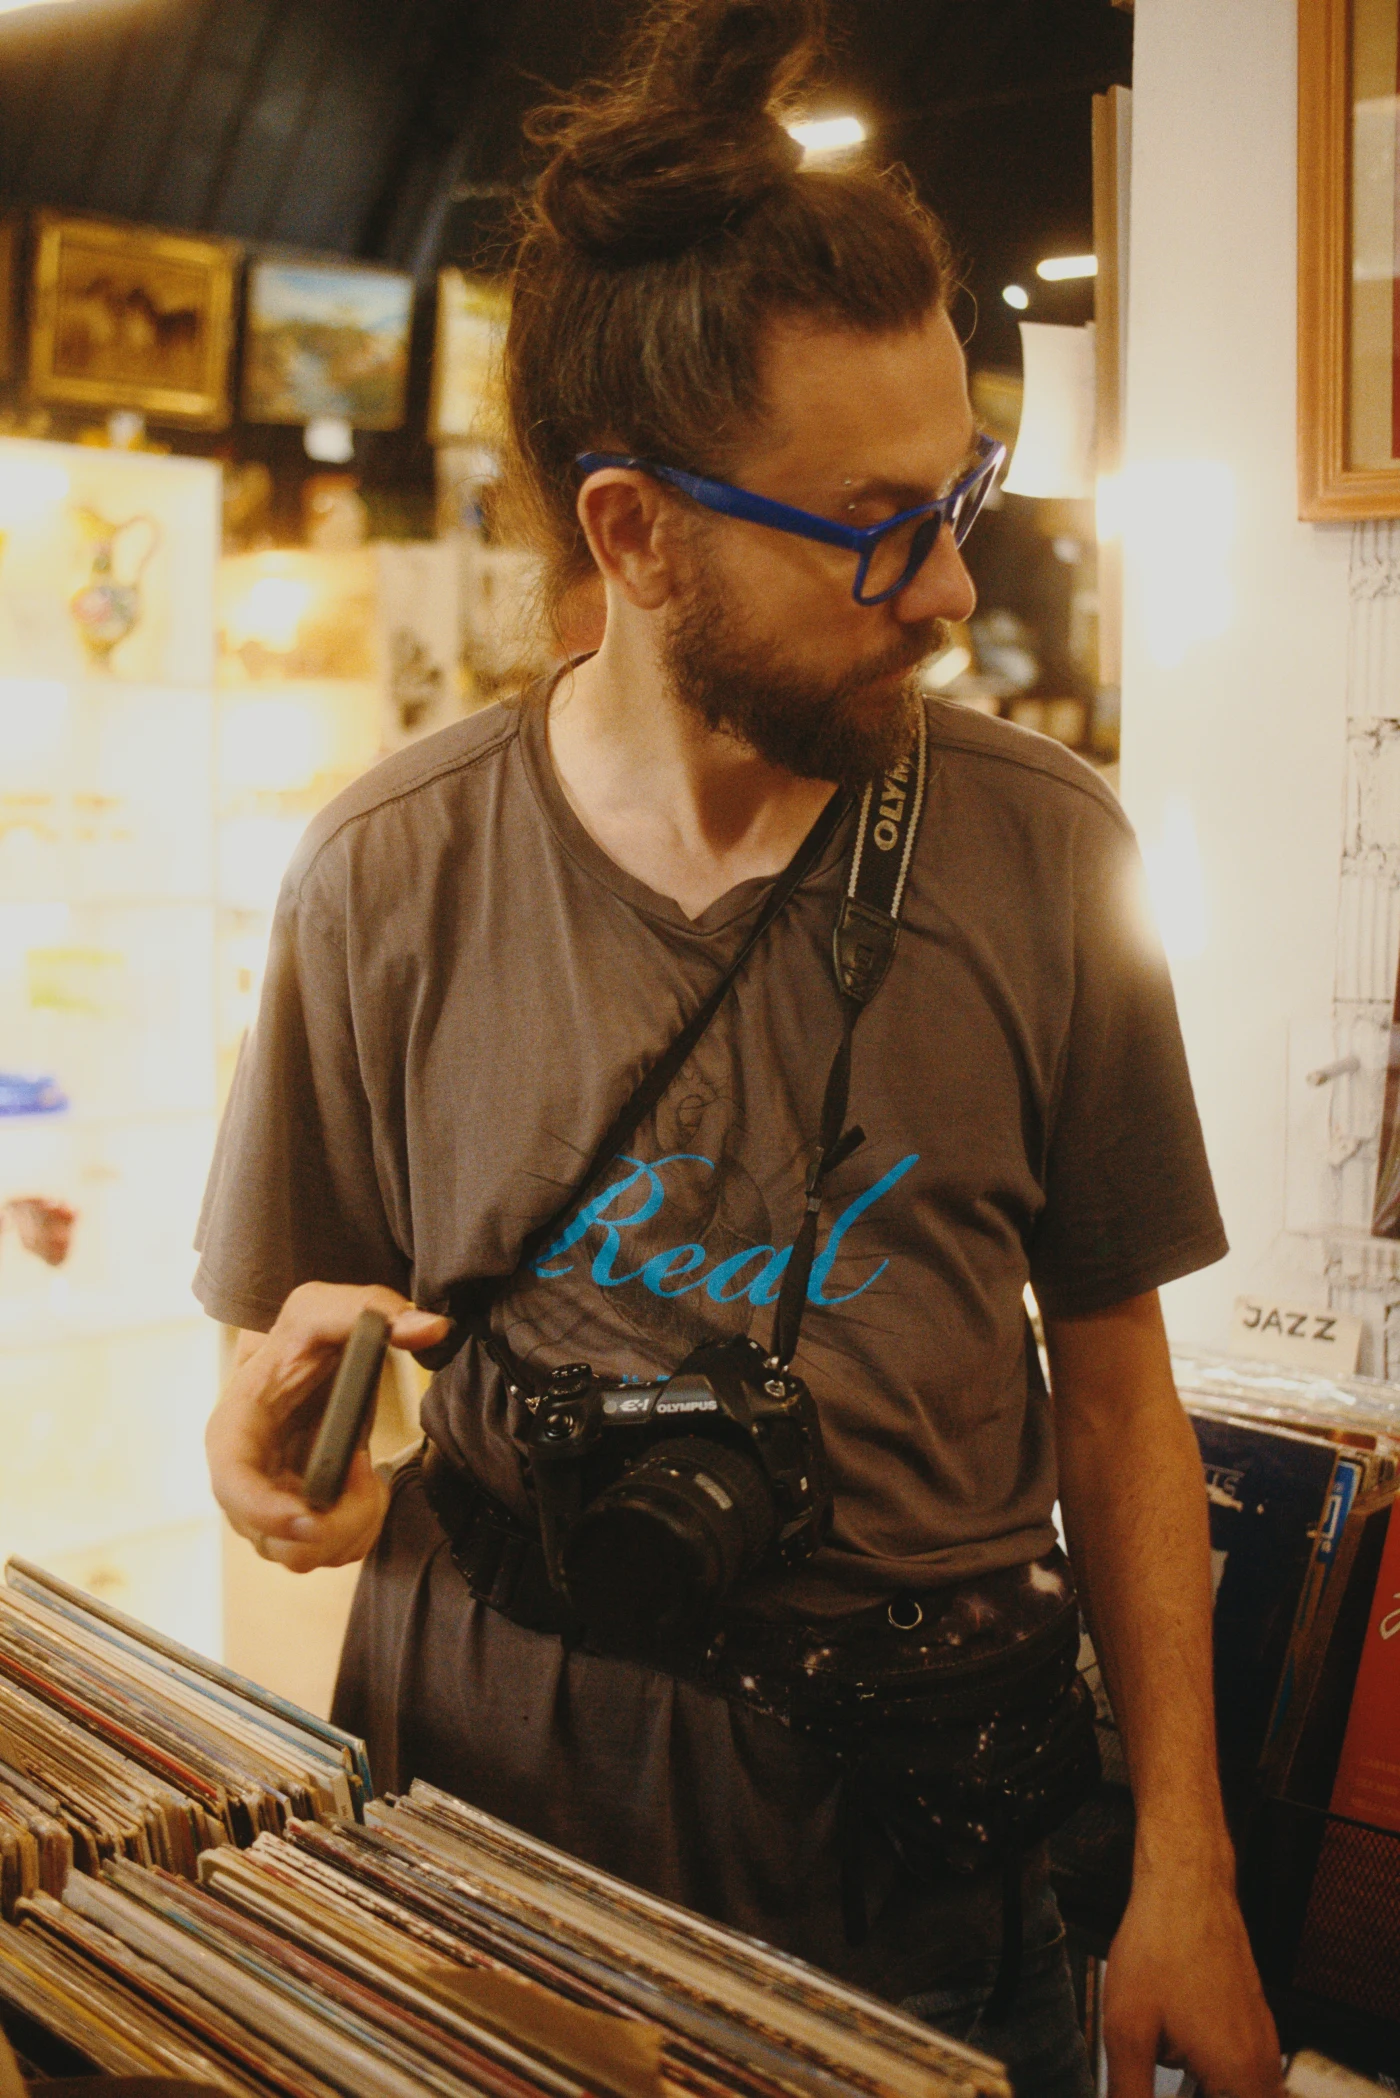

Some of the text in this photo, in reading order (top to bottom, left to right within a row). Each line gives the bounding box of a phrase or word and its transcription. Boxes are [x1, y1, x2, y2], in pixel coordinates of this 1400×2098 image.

[873, 756, 911, 851] OLYM
[530, 1153, 920, 1306] Real
[1242, 1304, 1338, 1342] JAZZ
[656, 1400, 718, 1414] OLYMPUS
